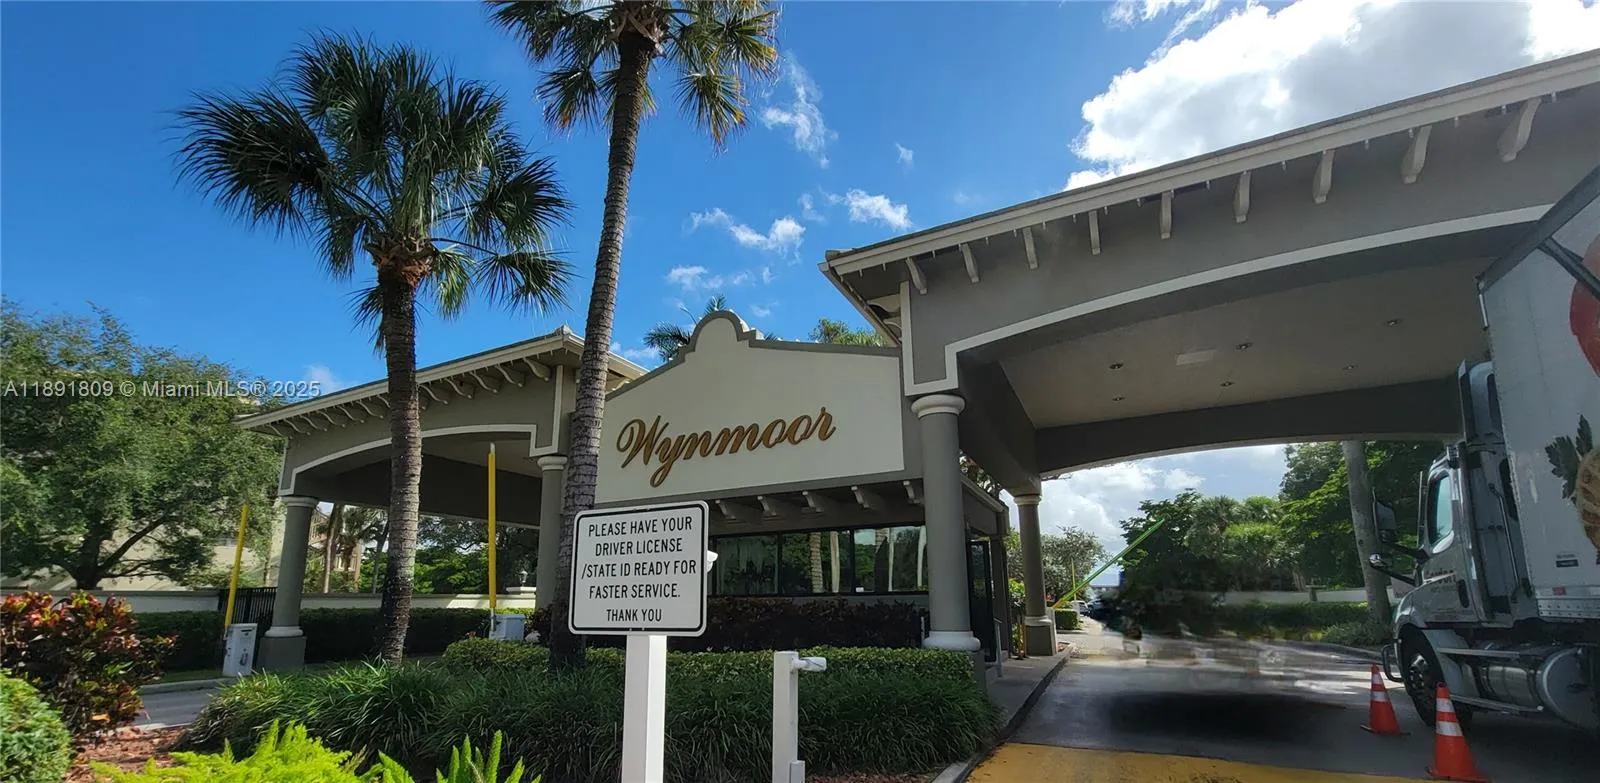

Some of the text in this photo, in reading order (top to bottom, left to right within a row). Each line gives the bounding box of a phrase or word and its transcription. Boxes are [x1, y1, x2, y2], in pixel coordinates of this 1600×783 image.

[616, 406, 837, 488] Wynmoor
[588, 516, 692, 537] PLEASE HAVE YOUR
[595, 538, 683, 556] DRIVER LICENSE
[581, 559, 697, 579] /STATE ID READY FOR
[589, 583, 681, 599] FASTER SERVICE.
[606, 608, 662, 622] THANK YOU
